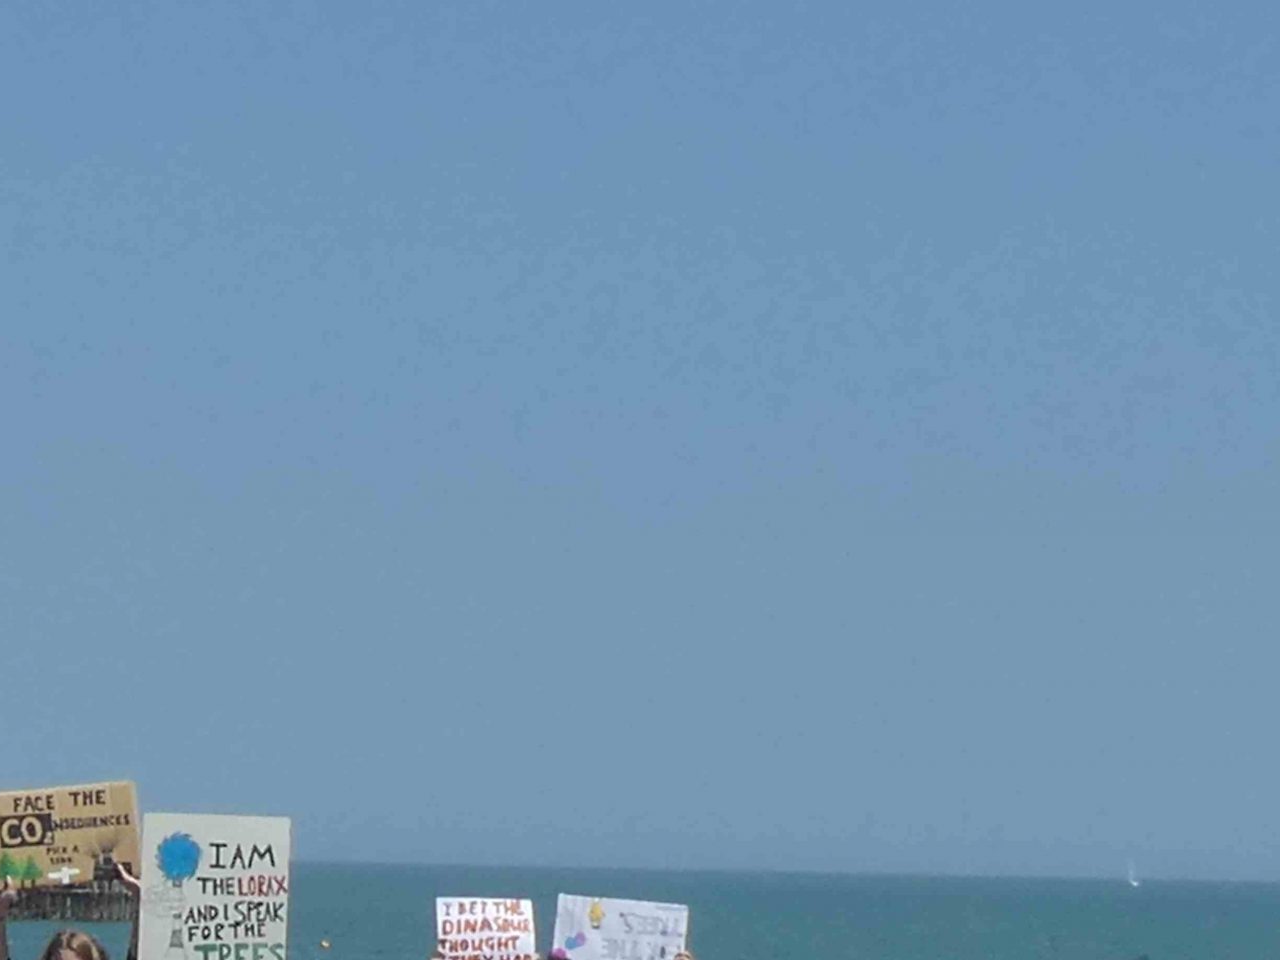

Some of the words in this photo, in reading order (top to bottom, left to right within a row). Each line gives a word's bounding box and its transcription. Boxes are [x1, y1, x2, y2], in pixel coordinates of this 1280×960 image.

[13, 793, 55, 813] FACE
[68, 789, 107, 807] THE
[209, 842, 228, 869] I
[230, 842, 276, 870] AM
[196, 876, 236, 897] THE
[238, 875, 288, 898] LORAX
[184, 904, 219, 925] AND
[223, 904, 230, 921] I
[233, 900, 285, 924] SPEAK
[442, 902, 452, 916] I
[457, 901, 487, 916] BET
[492, 900, 524, 916] THE
[187, 924, 226, 943] FOR
[229, 922, 266, 939] THE
[438, 935, 520, 953] THOUGHT
